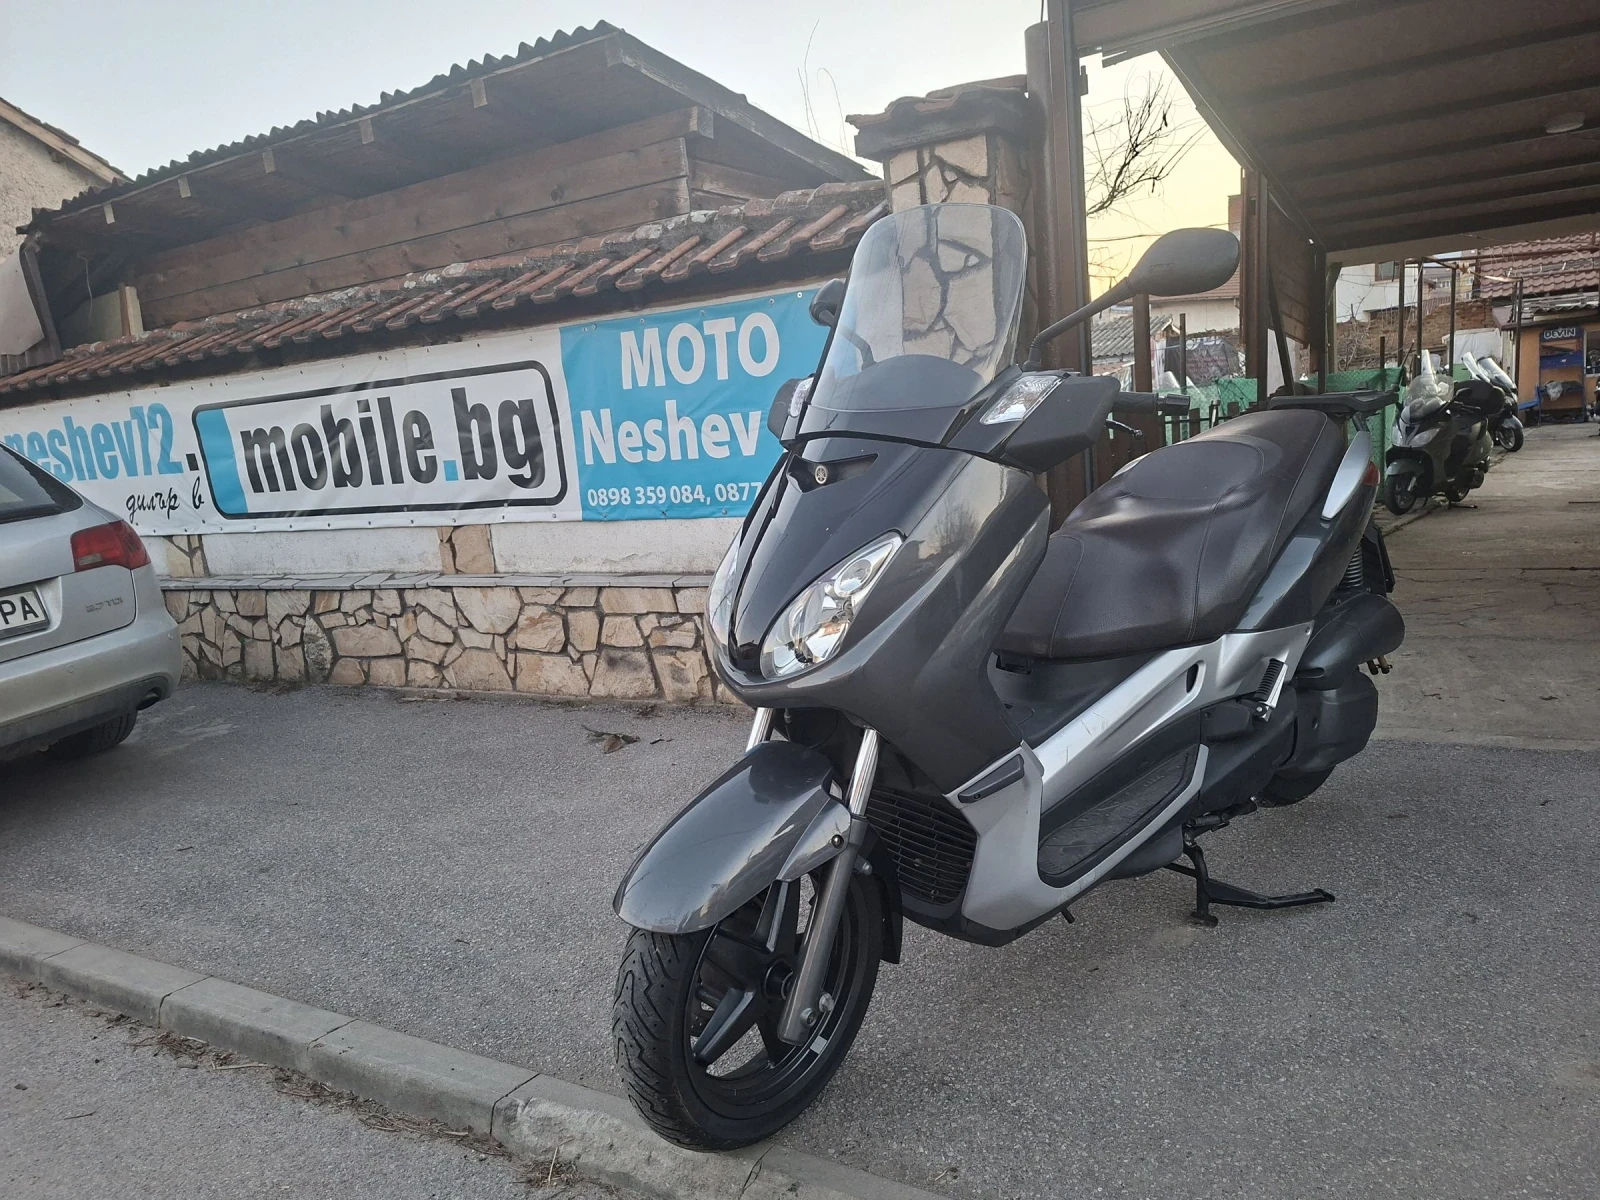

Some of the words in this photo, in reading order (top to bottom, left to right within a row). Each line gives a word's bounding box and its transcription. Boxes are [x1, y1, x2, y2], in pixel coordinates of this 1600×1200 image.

[619, 312, 780, 390] MOTO
[1543, 327, 1576, 339] DEVIN
[239, 386, 546, 493] mobile.bg
[580, 399, 762, 465] Neshev
[587, 487, 632, 507] 0898
[635, 486, 666, 505] 359
[669, 484, 711, 505] 084,
[0, 596, 39, 625] PA
